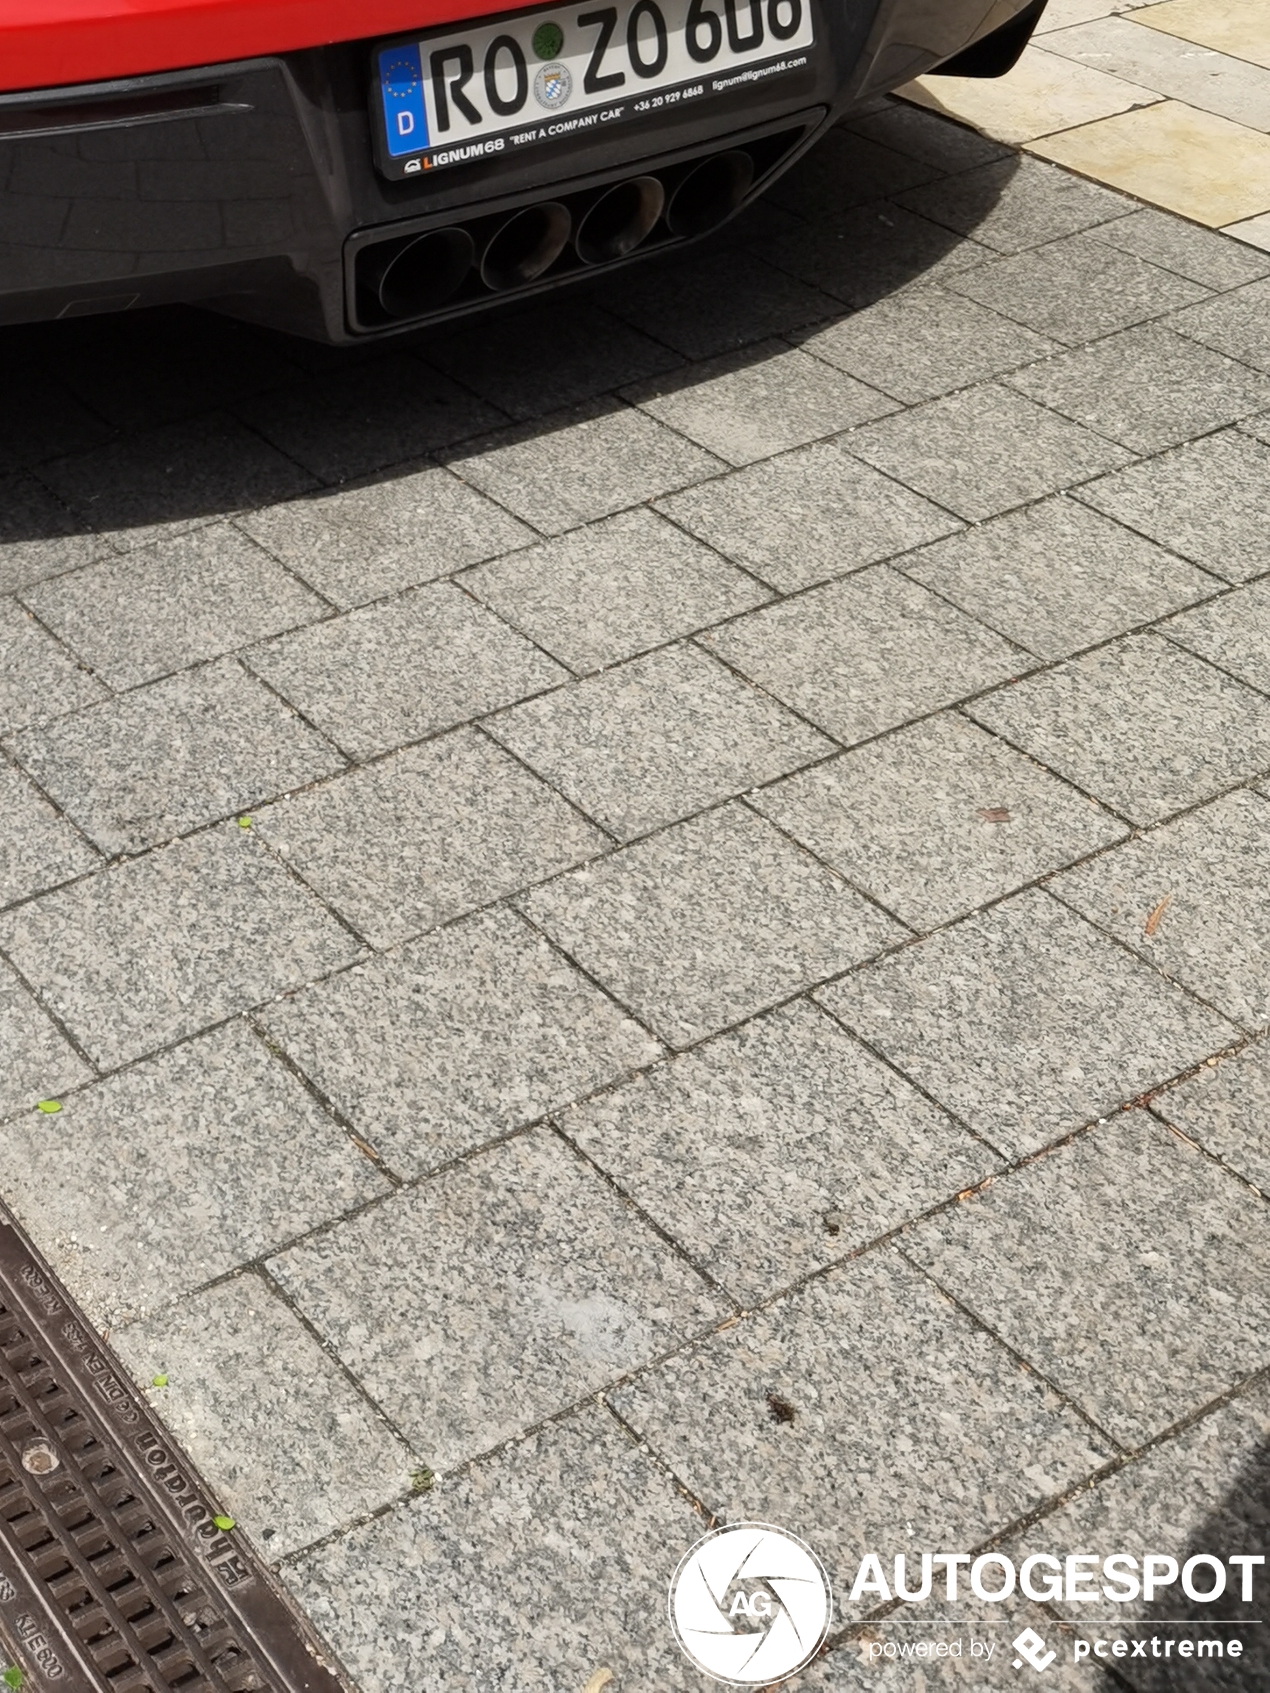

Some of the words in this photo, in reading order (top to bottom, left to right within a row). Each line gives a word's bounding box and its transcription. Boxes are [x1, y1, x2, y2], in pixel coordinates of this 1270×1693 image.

[430, 34, 529, 134] RO
[576, 0, 669, 95] ZO
[397, 110, 415, 135] D
[423, 138, 505, 170] LIGNUM68
[538, 128, 547, 138] A
[548, 115, 599, 137] COMPANY
[633, 102, 650, 112] +36
[651, 98, 664, 108] 20
[664, 92, 682, 105] 929
[682, 85, 704, 100] 6868
[712, 57, 807, 91] lignum@lignum68.com
[82, 1352, 107, 1375] EN
[93, 1373, 129, 1405] DIN
[134, 1431, 235, 1562] hauraton
